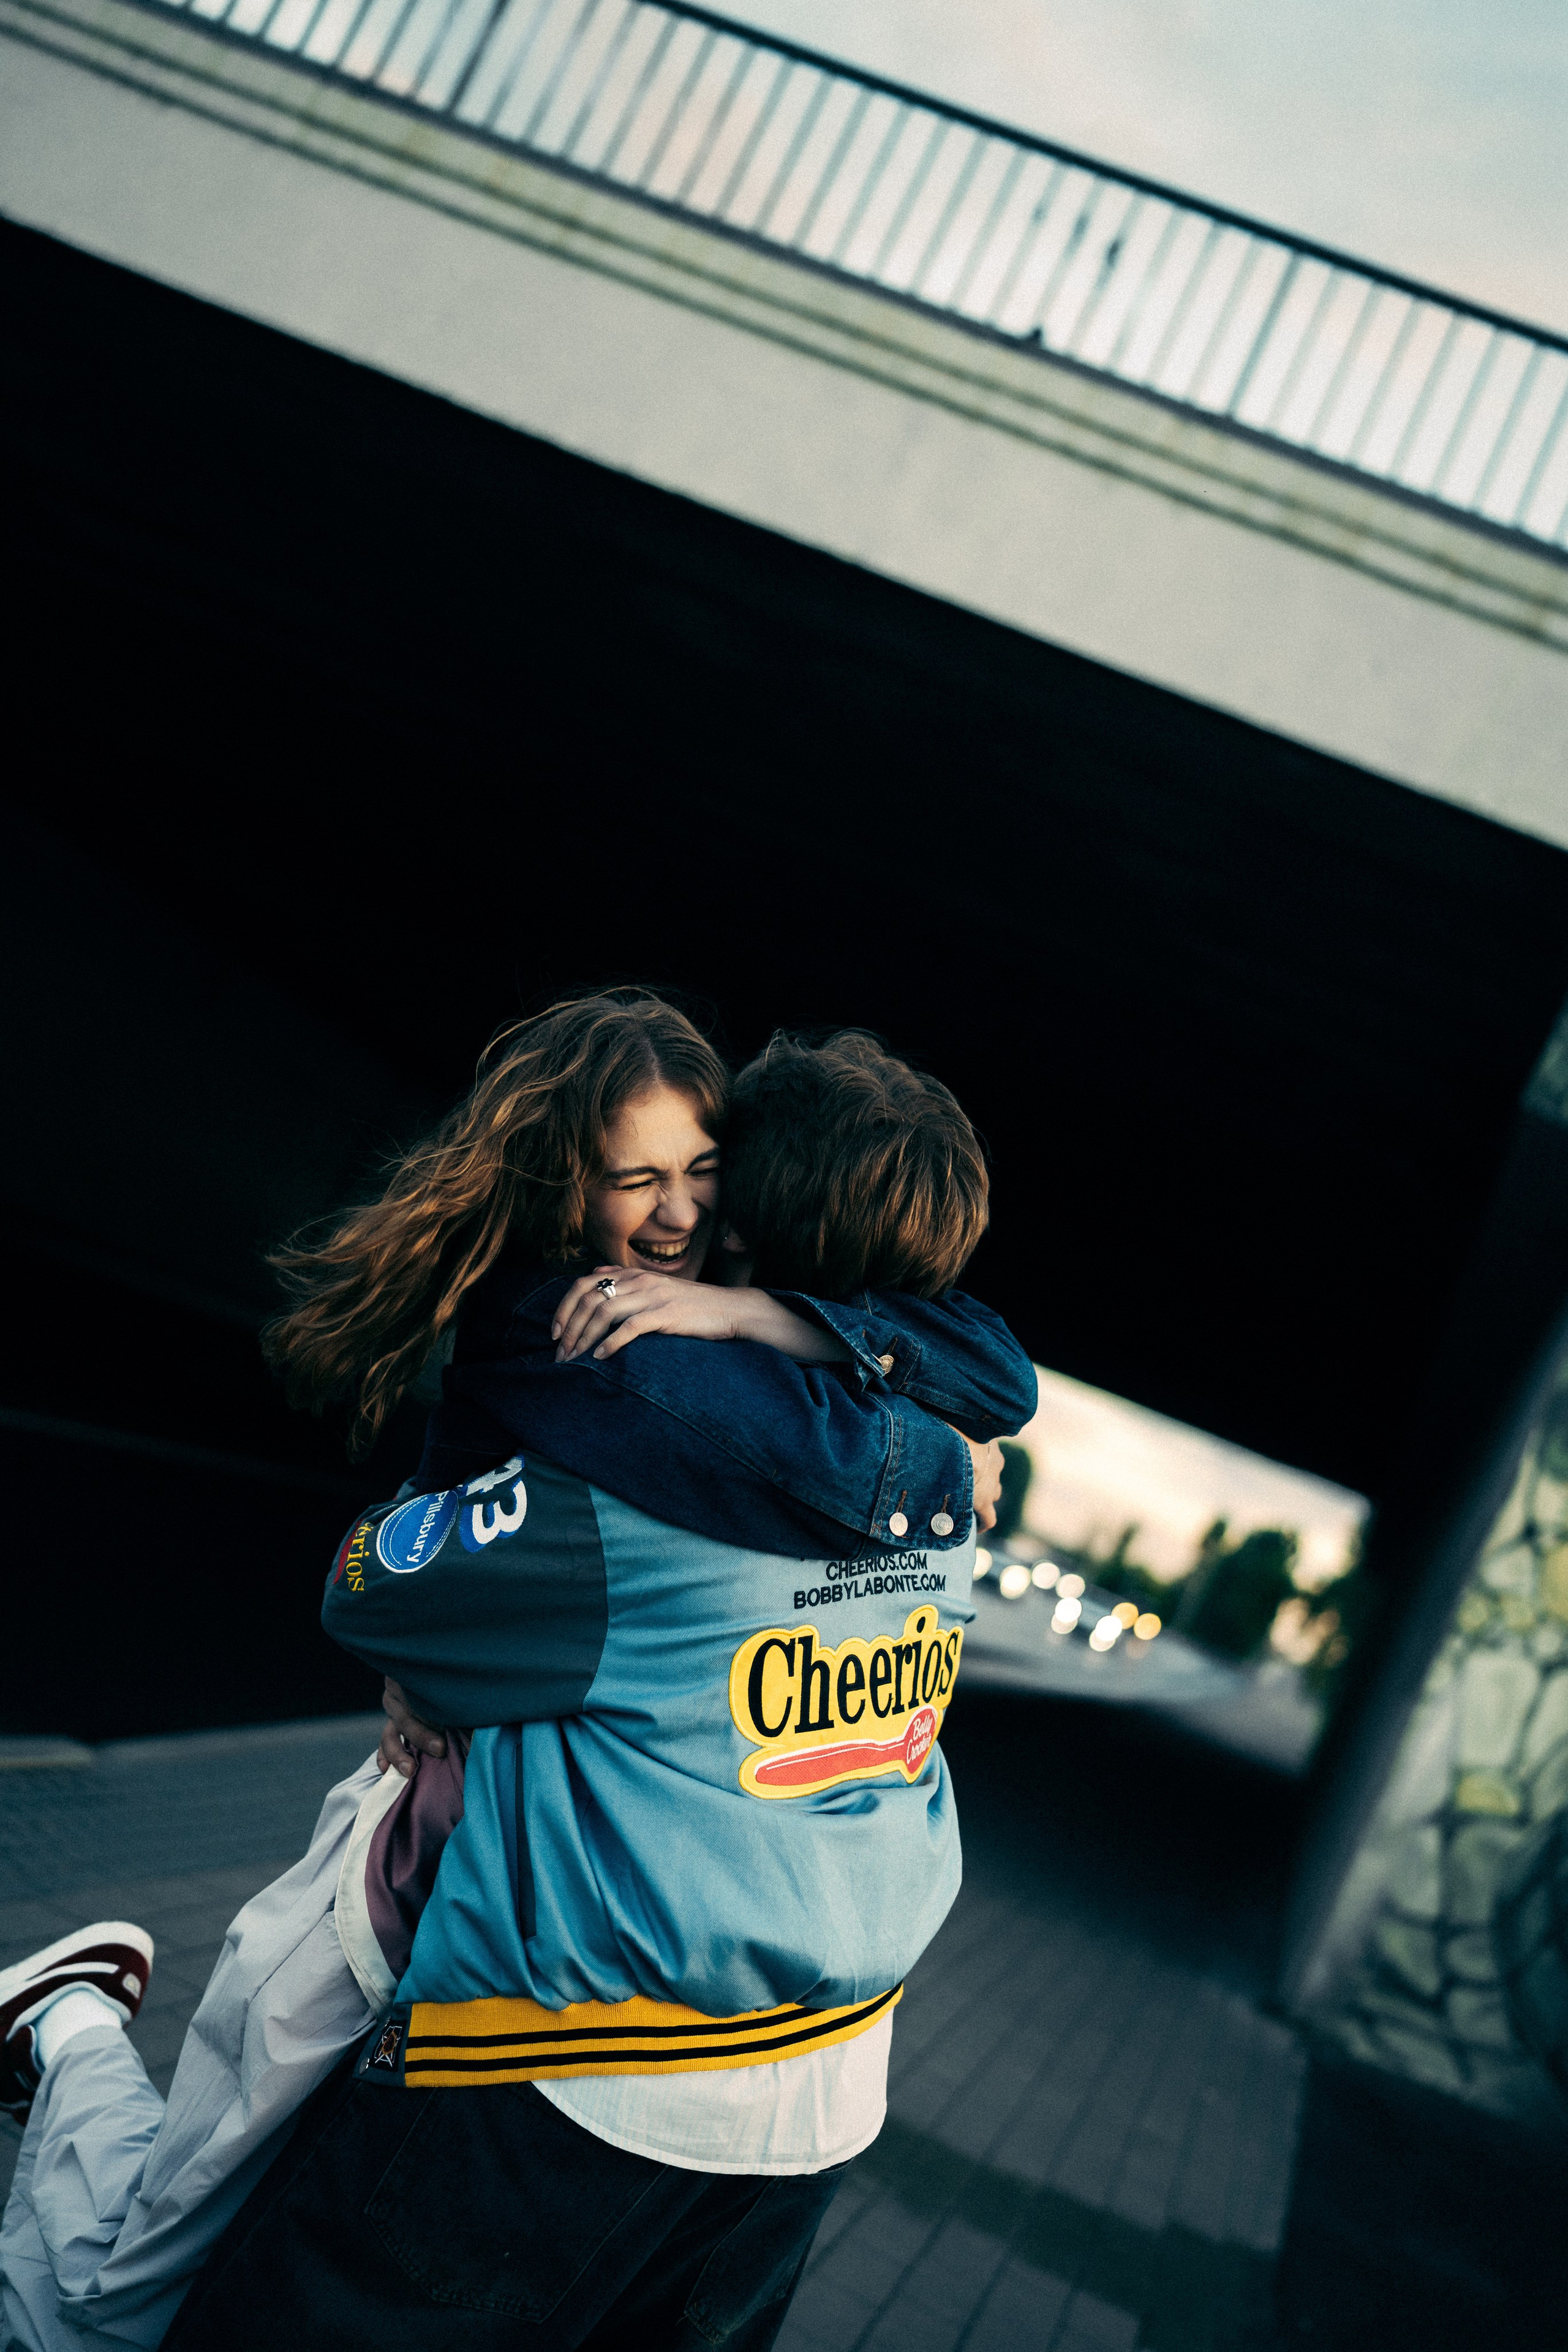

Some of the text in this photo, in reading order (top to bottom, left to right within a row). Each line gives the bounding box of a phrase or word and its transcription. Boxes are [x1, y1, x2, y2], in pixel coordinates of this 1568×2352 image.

[407, 1490, 450, 1562] Pillsbury
[794, 1574, 946, 1609] BOBBYLABONTE.COM
[826, 1551, 927, 1580] CHEERIOS.COM
[748, 1616, 959, 1737] Cheerios
